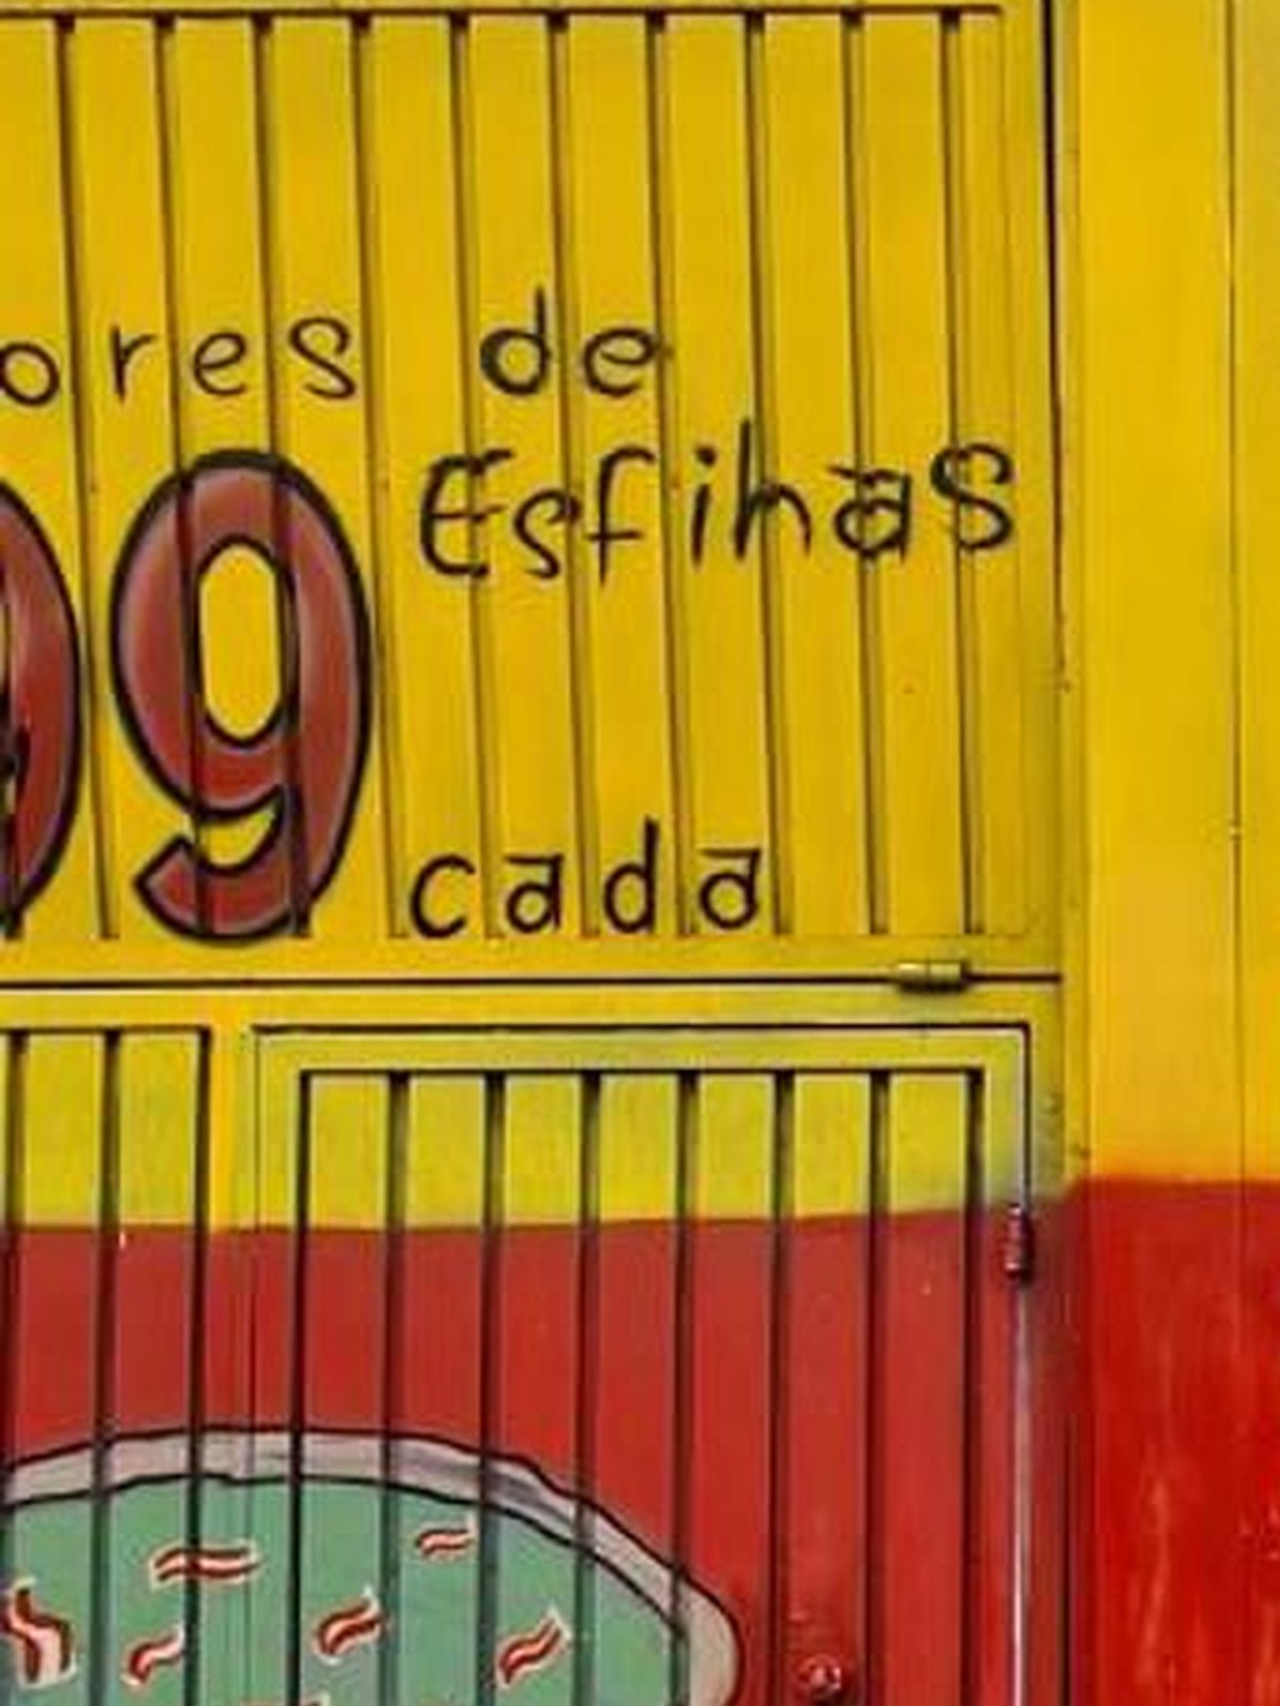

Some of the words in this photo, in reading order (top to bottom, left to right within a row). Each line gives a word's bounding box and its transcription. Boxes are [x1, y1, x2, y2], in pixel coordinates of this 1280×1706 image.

[0, 314, 360, 407] ores
[479, 286, 667, 397] de
[418, 415, 1016, 585] Esfihas
[409, 815, 762, 939] cada
